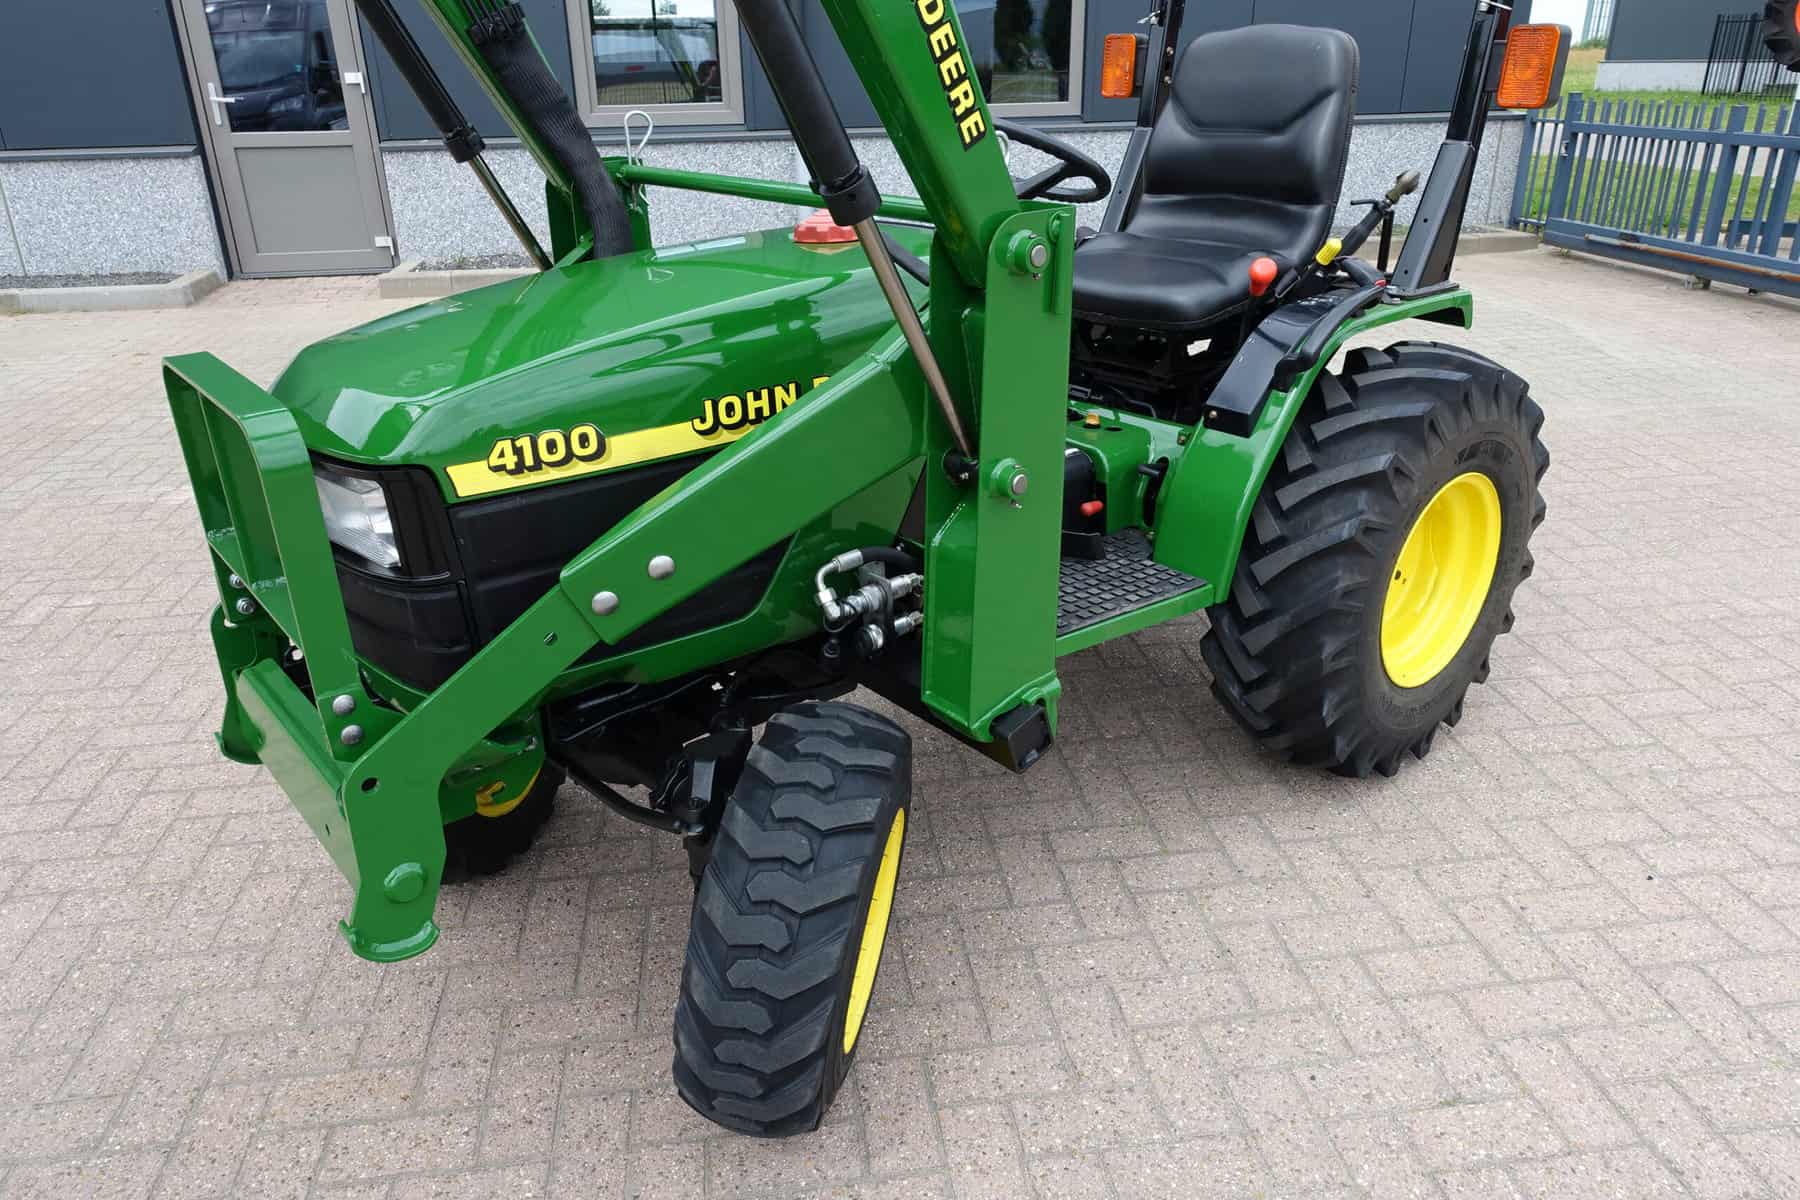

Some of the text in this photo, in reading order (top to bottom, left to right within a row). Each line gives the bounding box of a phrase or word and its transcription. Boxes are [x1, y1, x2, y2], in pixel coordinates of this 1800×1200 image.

[916, 0, 986, 148] DEERE
[691, 382, 798, 433] JOHN
[488, 424, 604, 473] 4100
